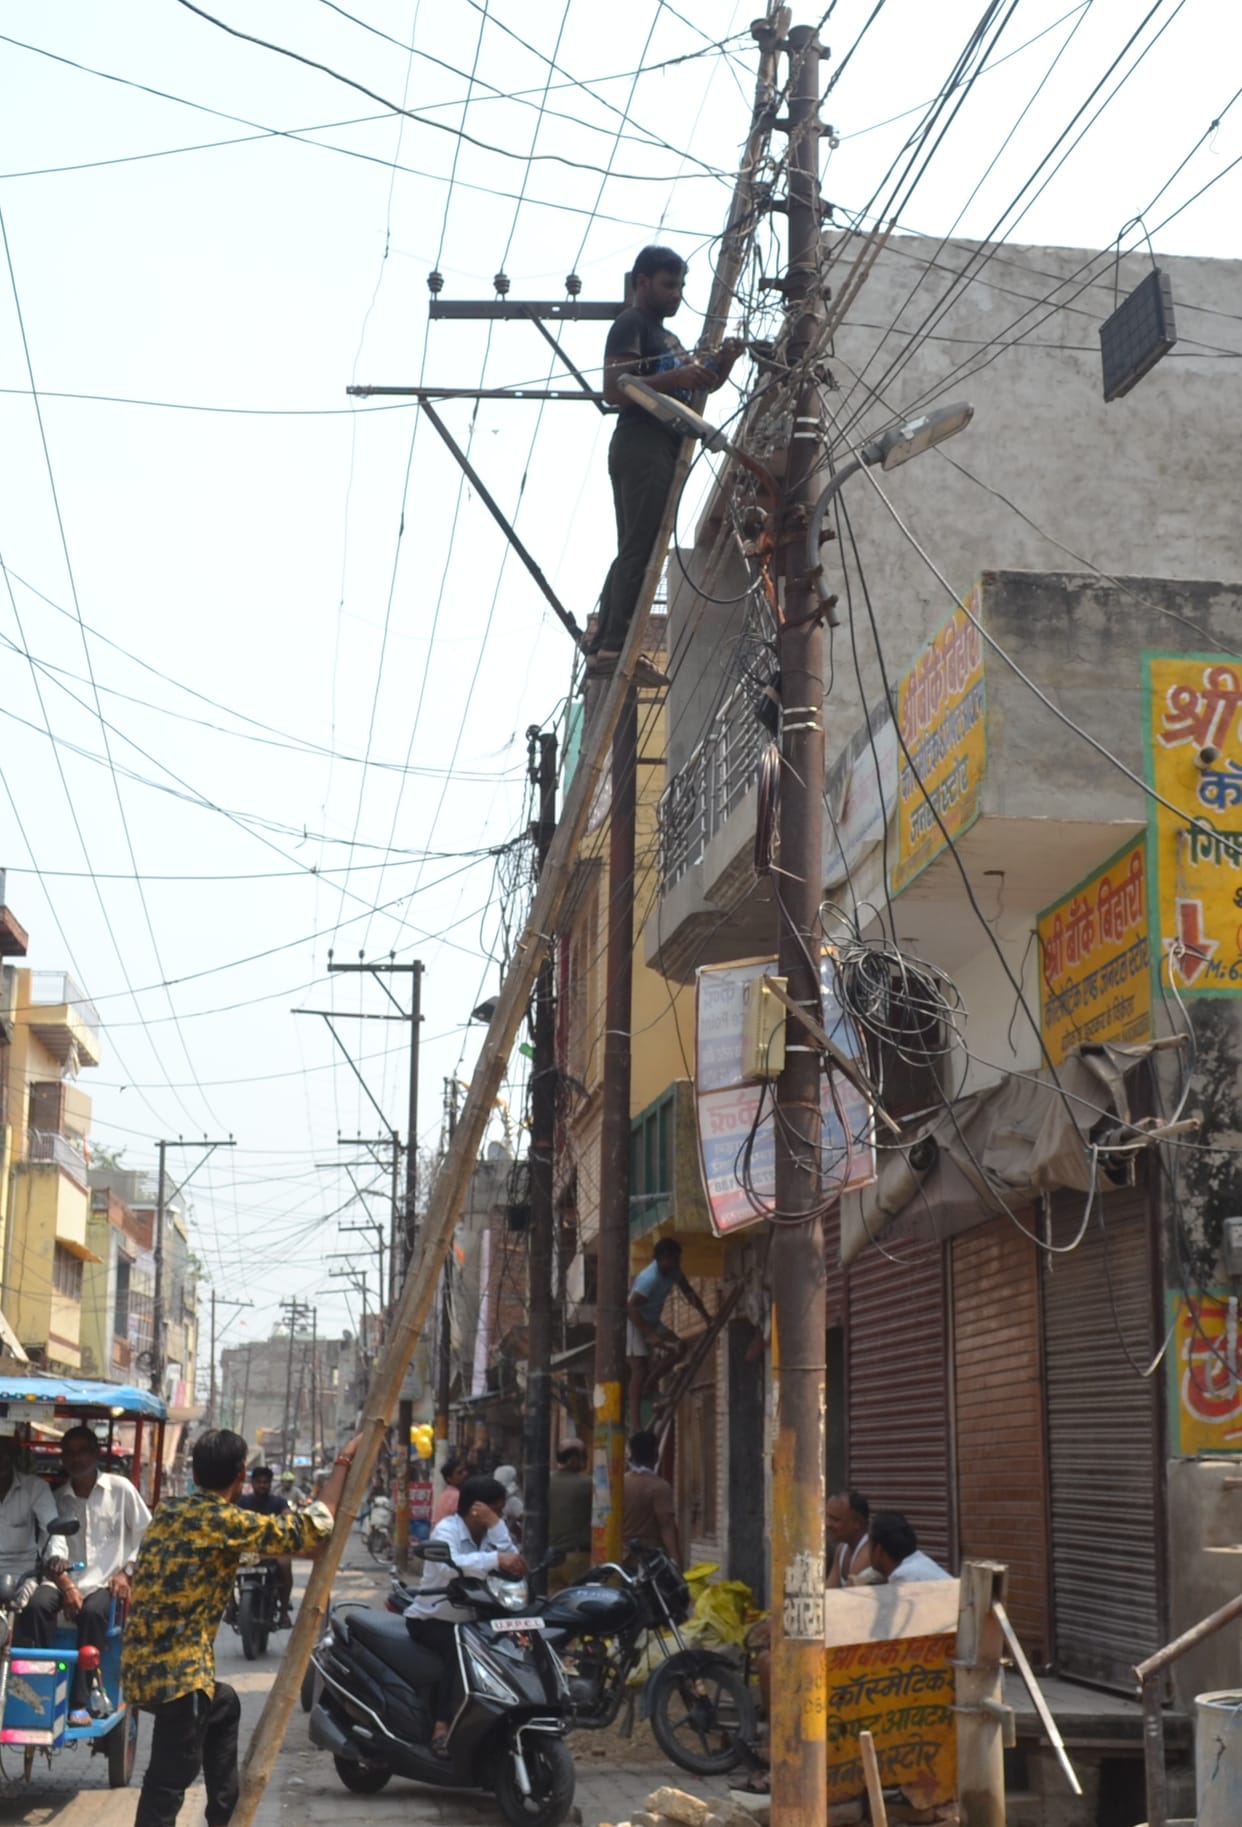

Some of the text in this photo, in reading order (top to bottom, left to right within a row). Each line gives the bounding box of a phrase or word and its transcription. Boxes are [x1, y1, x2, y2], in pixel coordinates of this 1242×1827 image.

[1156, 666, 1240, 752] श्री
[1045, 850, 1144, 981] श्री बाँके बिहारी
[829, 1664, 948, 1711] कॉस्मेटिक
[886, 1732, 942, 1779] स्टोर
